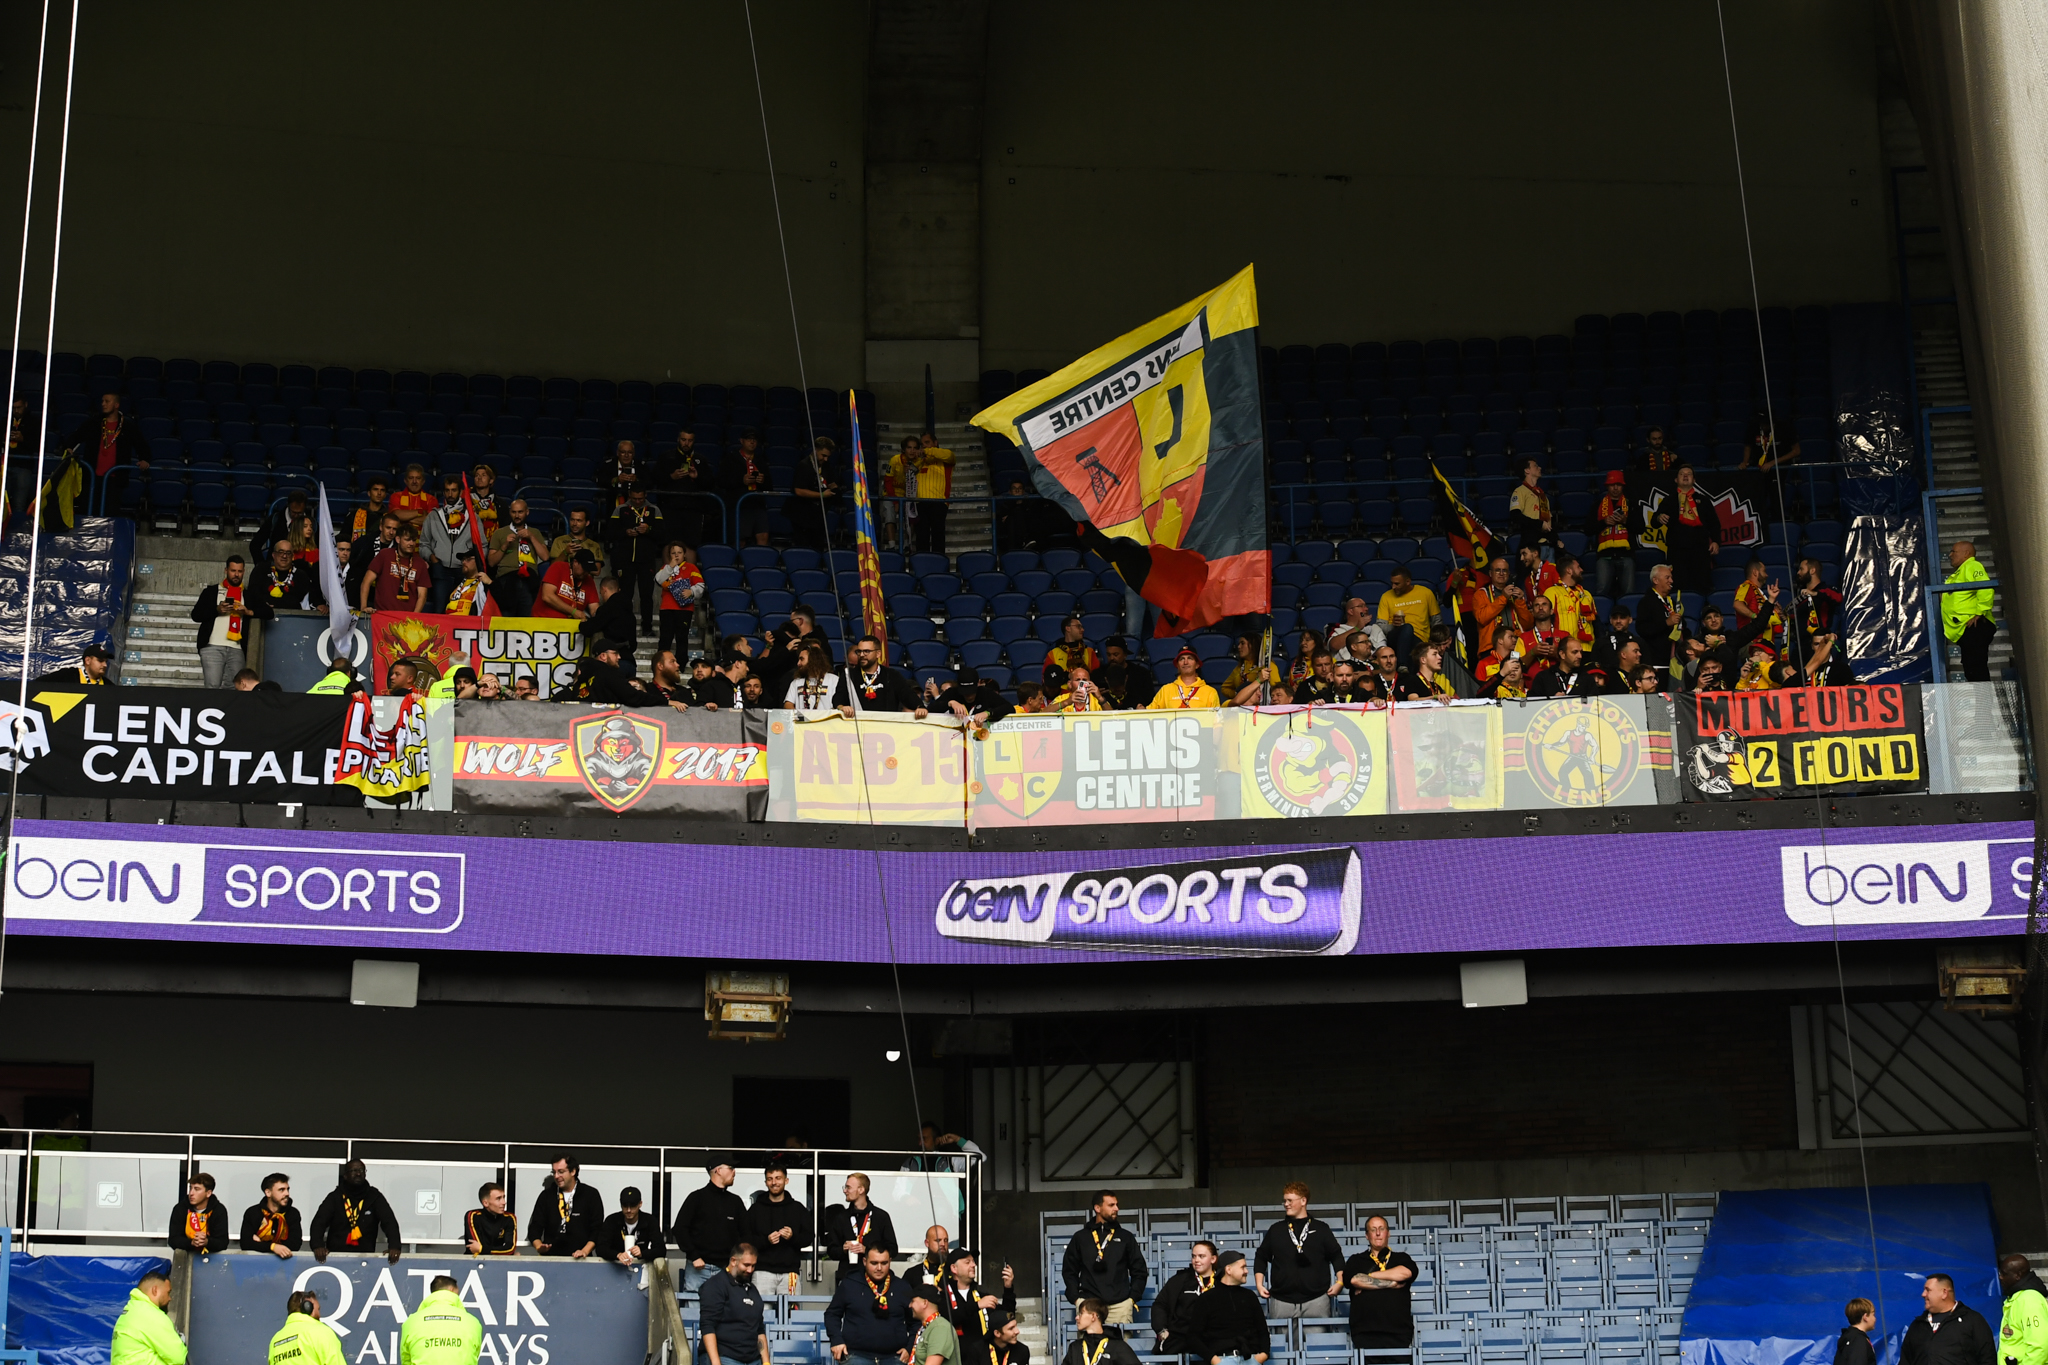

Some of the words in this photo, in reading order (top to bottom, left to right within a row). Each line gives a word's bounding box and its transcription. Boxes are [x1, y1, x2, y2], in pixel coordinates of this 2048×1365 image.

[454, 629, 585, 660] TURBU
[84, 704, 227, 745] LENS
[991, 722, 1014, 731] LENS
[1016, 721, 1052, 730] CENTRE
[1589, 699, 1637, 745] BOYS
[1701, 685, 1901, 731] MINEURS
[463, 741, 568, 778] WOLF
[674, 746, 760, 782] 2017
[800, 730, 898, 786] ATB
[911, 729, 971, 786] 15
[995, 740, 1011, 762] L
[1074, 717, 1201, 773] LENS
[1754, 746, 1775, 782] 2
[1799, 740, 1914, 782] FOND
[1027, 776, 1046, 799] C
[1075, 774, 1201, 810] CENTRE
[1255, 765, 1310, 818] TERMINUS
[1340, 791, 1359, 811] 30
[1357, 765, 1371, 797] ANS
[1553, 784, 1612, 805] LENS
[225, 864, 441, 914] SPORTS
[1068, 864, 1308, 924] SPORTS
[292, 1265, 550, 1338] QATAR
[273, 1347, 302, 1365] STEWARD
[355, 1331, 550, 1365] AIAYS
[425, 1337, 462, 1348] STEWARD
